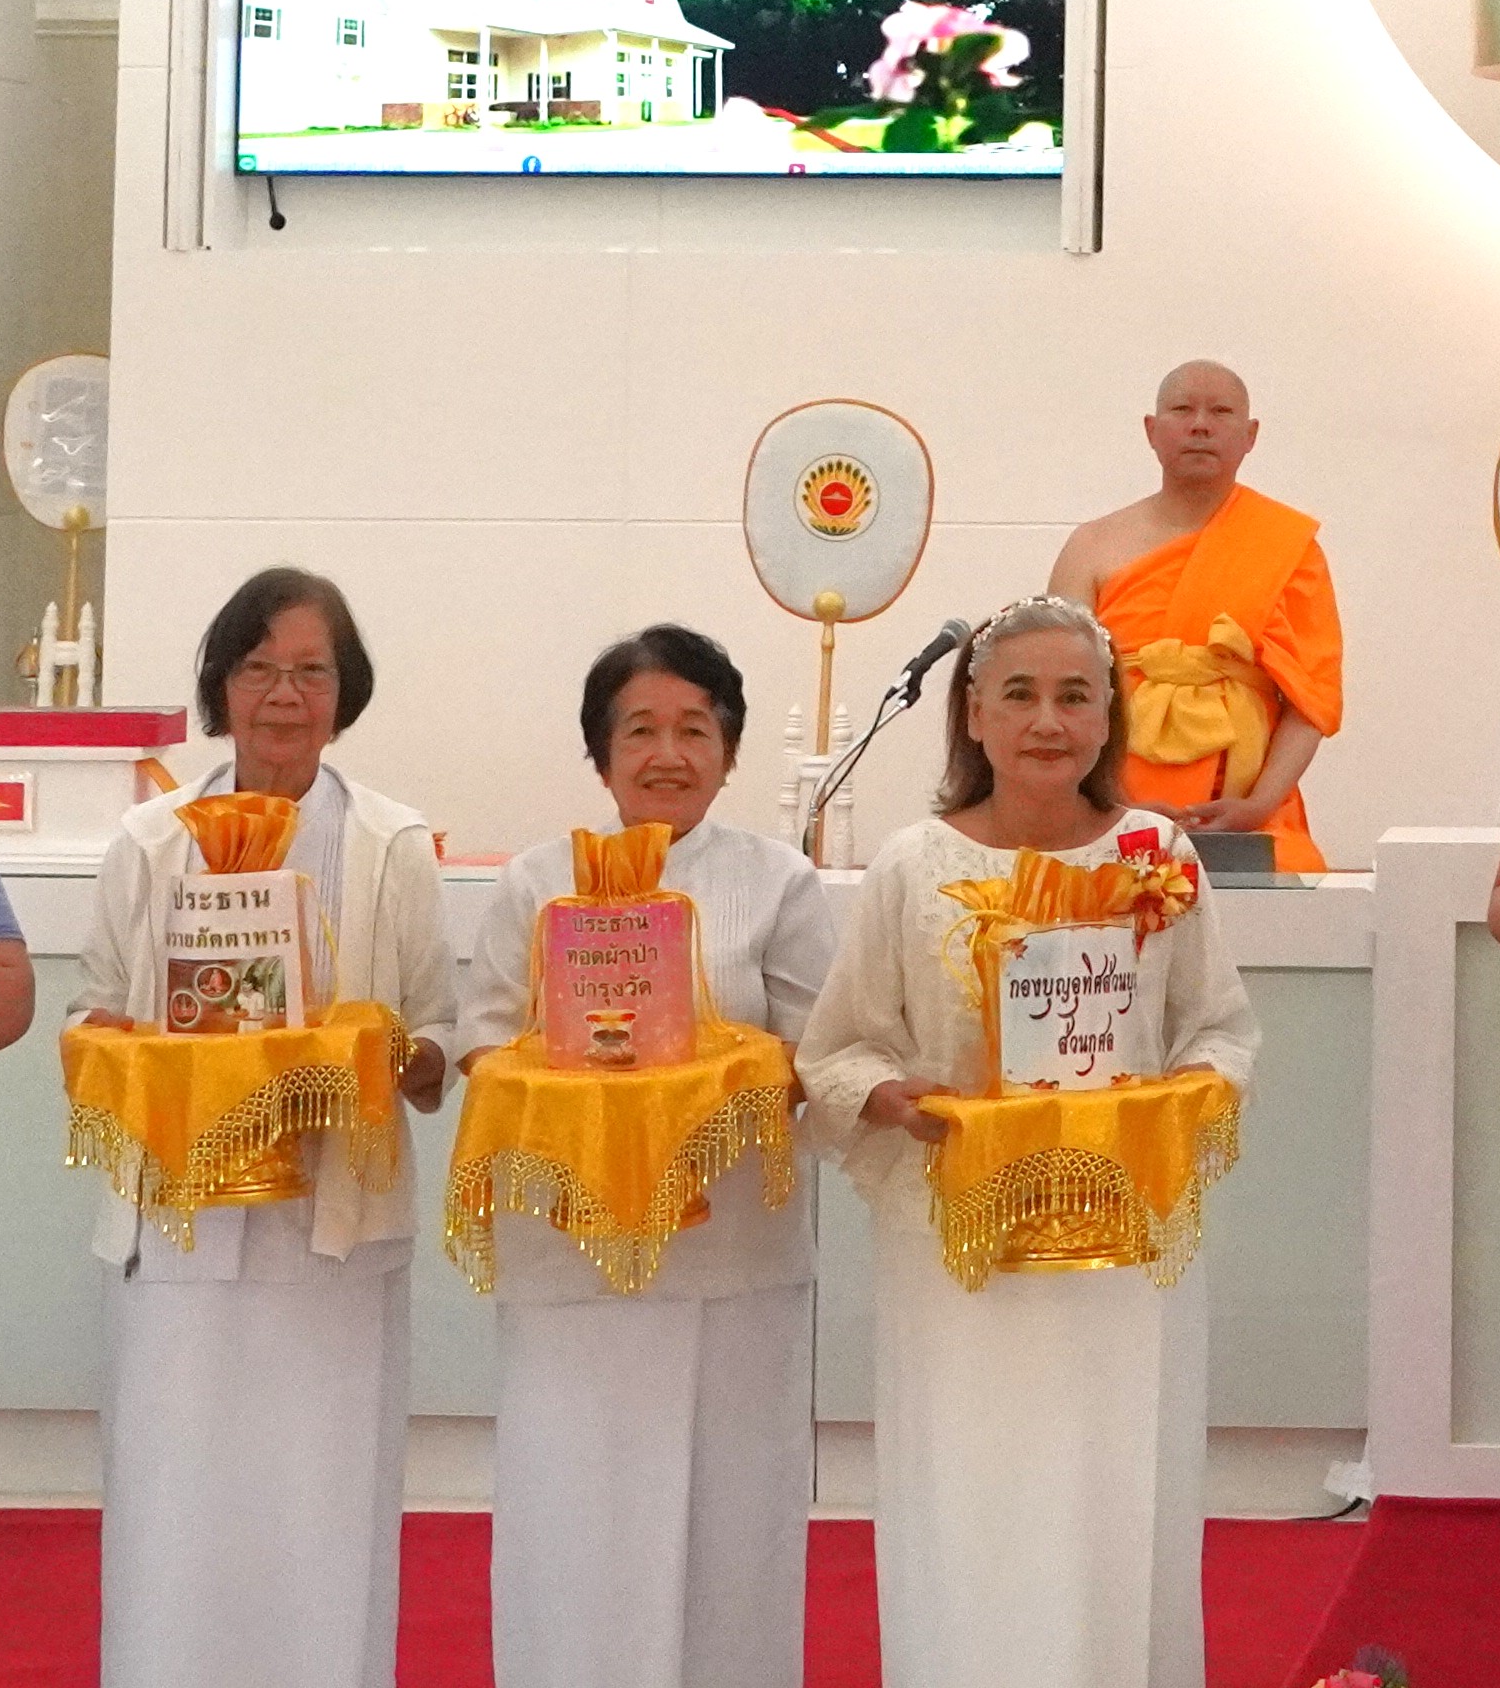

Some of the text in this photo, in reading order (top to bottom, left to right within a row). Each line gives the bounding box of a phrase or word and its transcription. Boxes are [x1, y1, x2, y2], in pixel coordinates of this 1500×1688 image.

[173, 879, 270, 911] ประธาน
[572, 914, 650, 933] ประธาน
[567, 942, 658, 965] ทอดผ้าป่า
[573, 974, 652, 1006] บำรุงวัด
